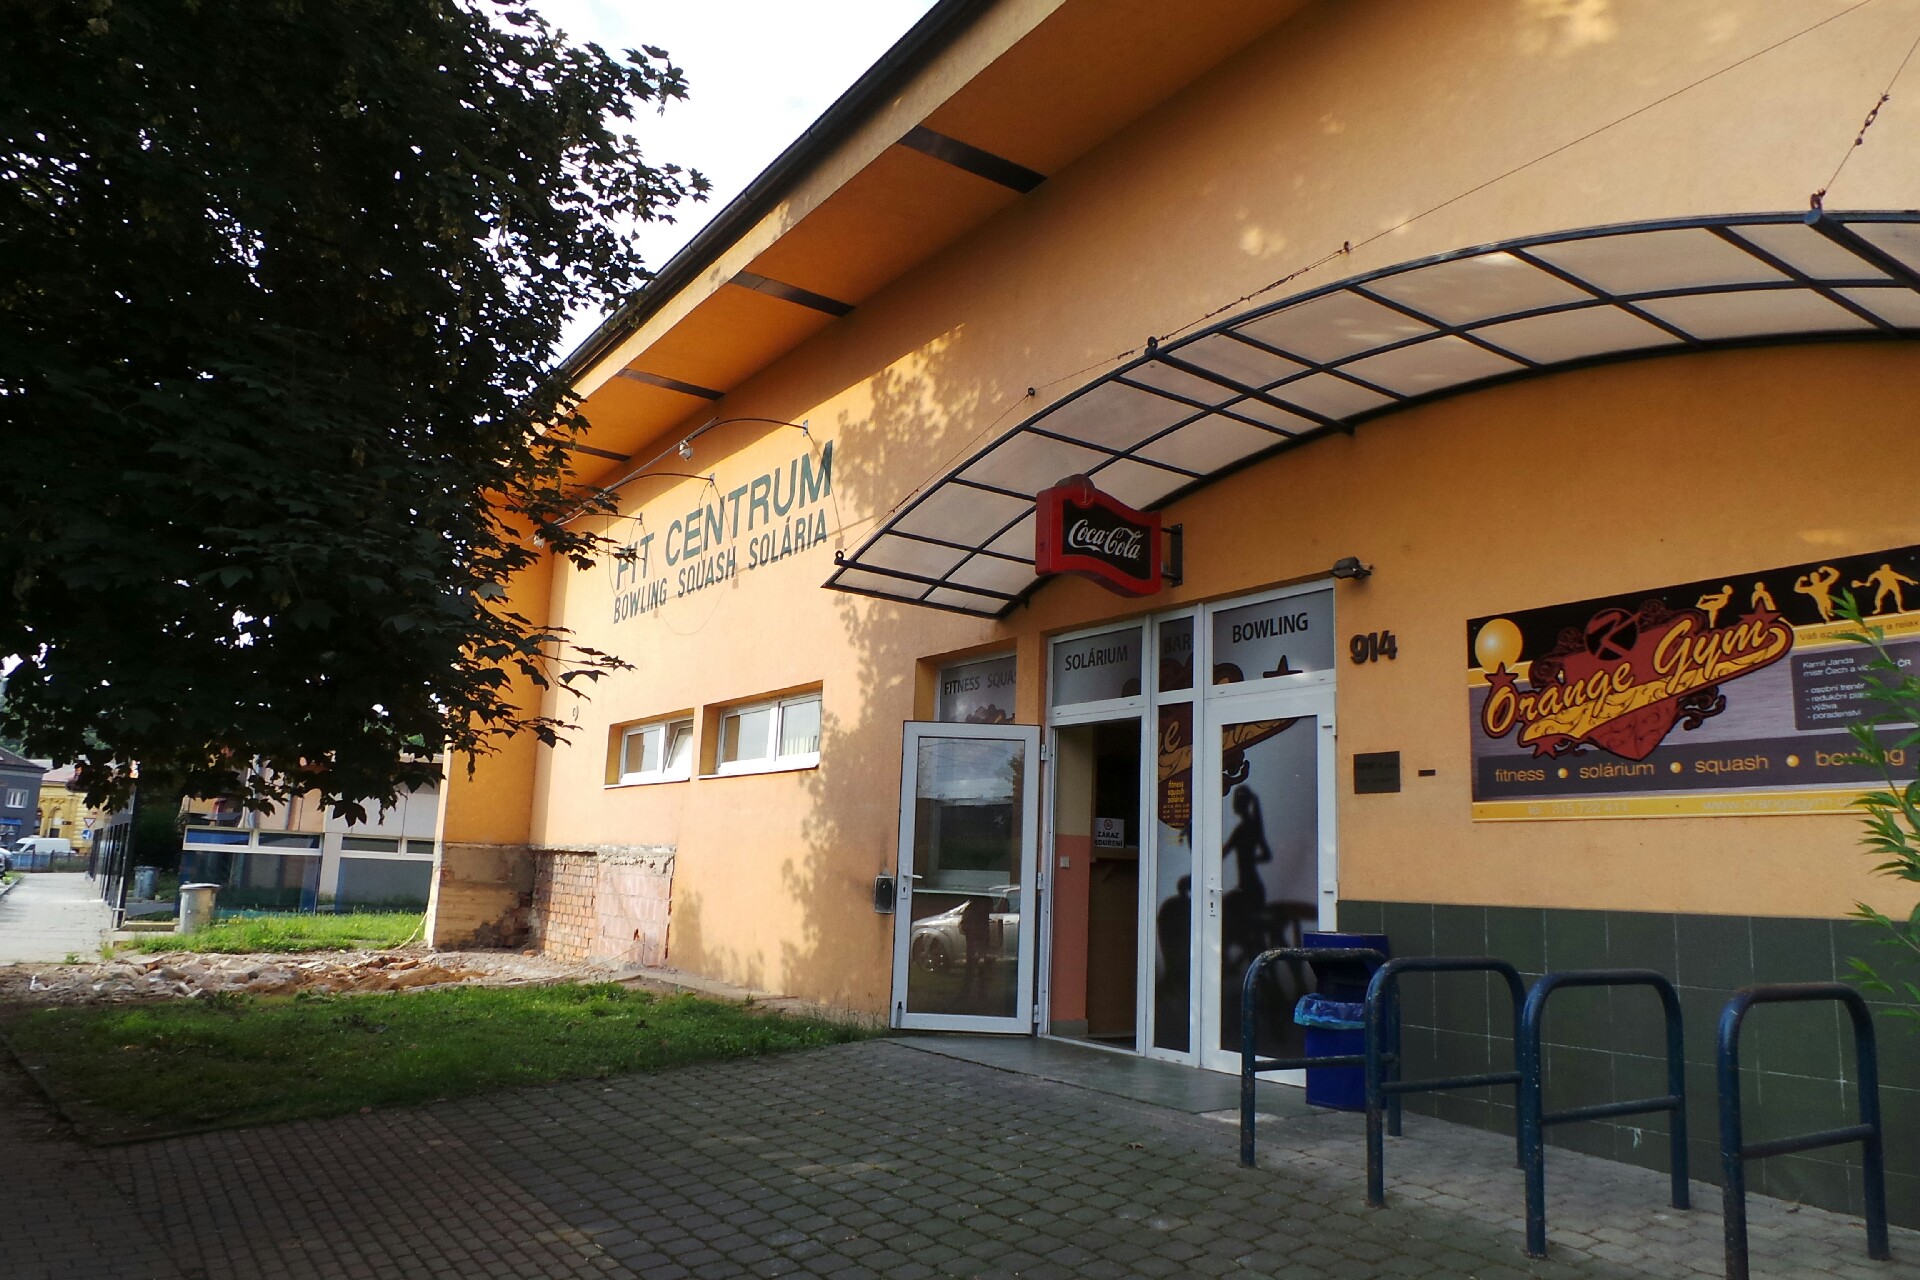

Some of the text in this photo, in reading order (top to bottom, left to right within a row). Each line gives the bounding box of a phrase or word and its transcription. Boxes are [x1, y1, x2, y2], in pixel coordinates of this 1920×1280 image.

[616, 439, 833, 591] FIT CENTRUM
[1067, 519, 1144, 559] Coca-Cola
[613, 508, 827, 624] BOWLING SQUASH SOLÁRIA
[1232, 612, 1309, 644] BOWLING
[1065, 645, 1128, 671] SOLÁRIUM
[1164, 633, 1191, 654] BAR
[1350, 630, 1398, 665] 914
[1486, 619, 1770, 733] Orange Gym
[1802, 657, 1854, 668] Kamil Janda
[1825, 666, 1848, 675] Čech
[944, 676, 980, 695] FITNESS
[1495, 768, 1545, 782] fitness
[1579, 762, 1654, 779] solárium
[1694, 754, 1769, 775] squash
